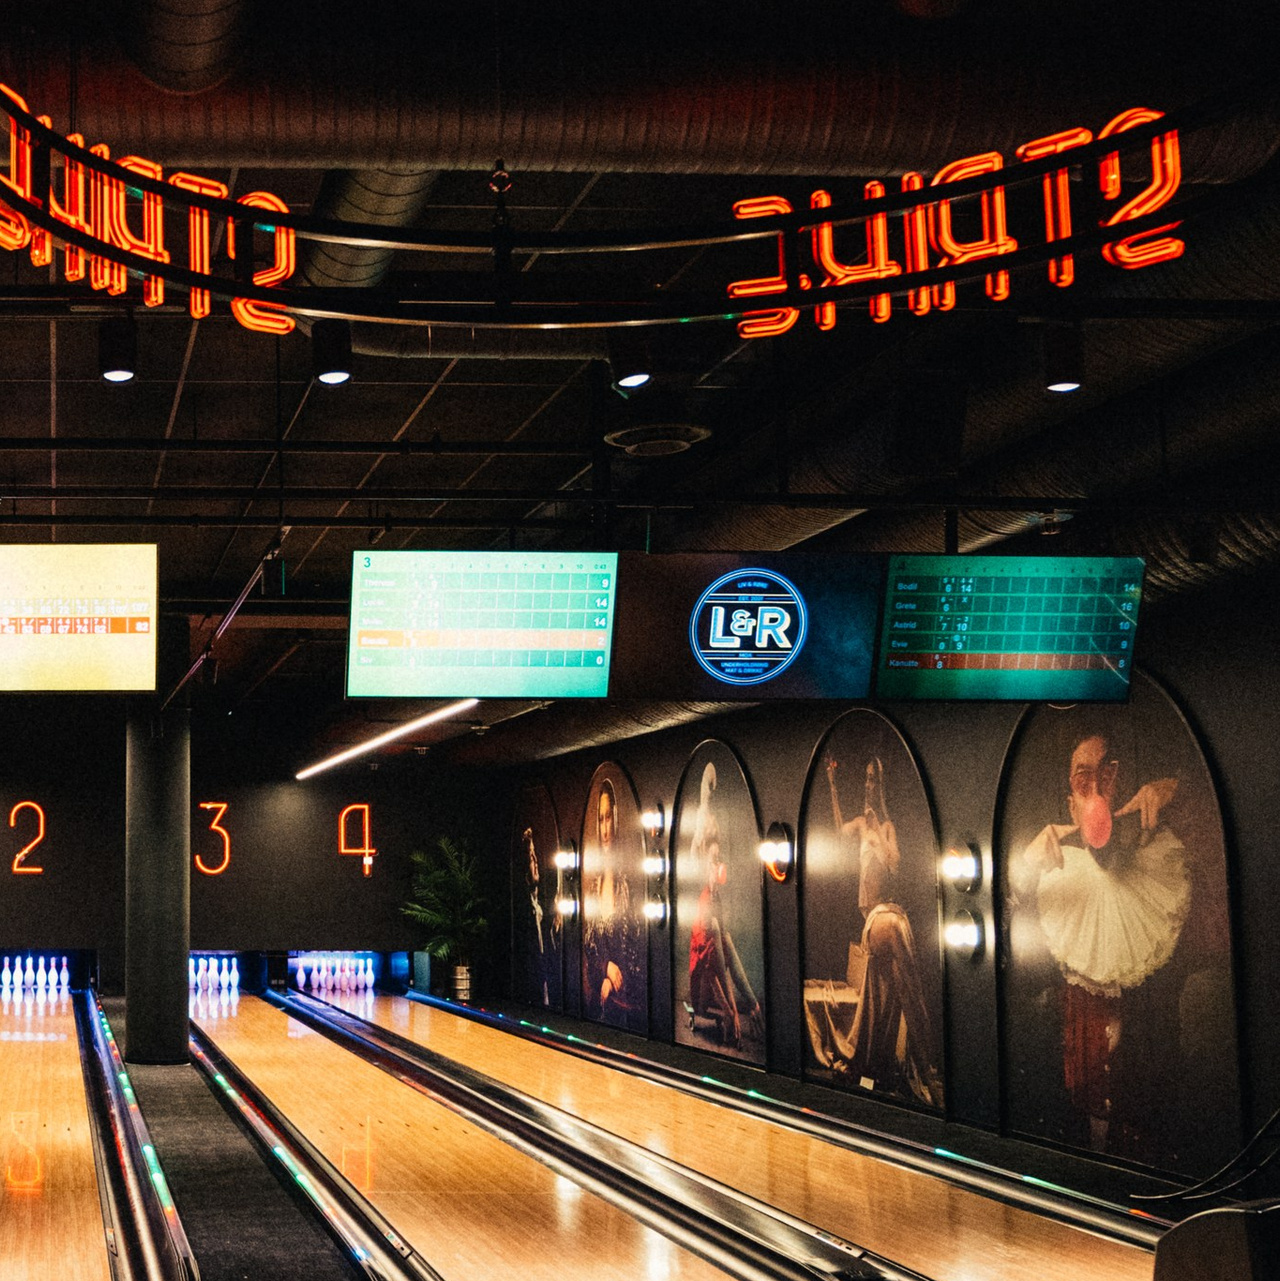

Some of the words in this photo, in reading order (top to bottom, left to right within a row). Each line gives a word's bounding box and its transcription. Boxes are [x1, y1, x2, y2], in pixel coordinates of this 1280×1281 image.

[364, 557, 371, 568] 3
[602, 579, 608, 588] 9
[945, 584, 952, 592] 6
[961, 584, 971, 592] 14
[1124, 584, 1135, 592] 14
[596, 599, 607, 608] 14
[944, 604, 950, 612] 6
[594, 618, 605, 626] 14
[893, 621, 917, 629] Astrid
[942, 623, 948, 631] 7
[957, 623, 968, 631] 10
[710, 606, 792, 648] L&R
[956, 642, 963, 650] 9
[596, 656, 603, 665] 0
[936, 661, 943, 669] 8
[1119, 660, 1125, 668] 8
[9, 800, 44, 873] 2
[194, 801, 230, 874] 3
[338, 803, 377, 877] 4
